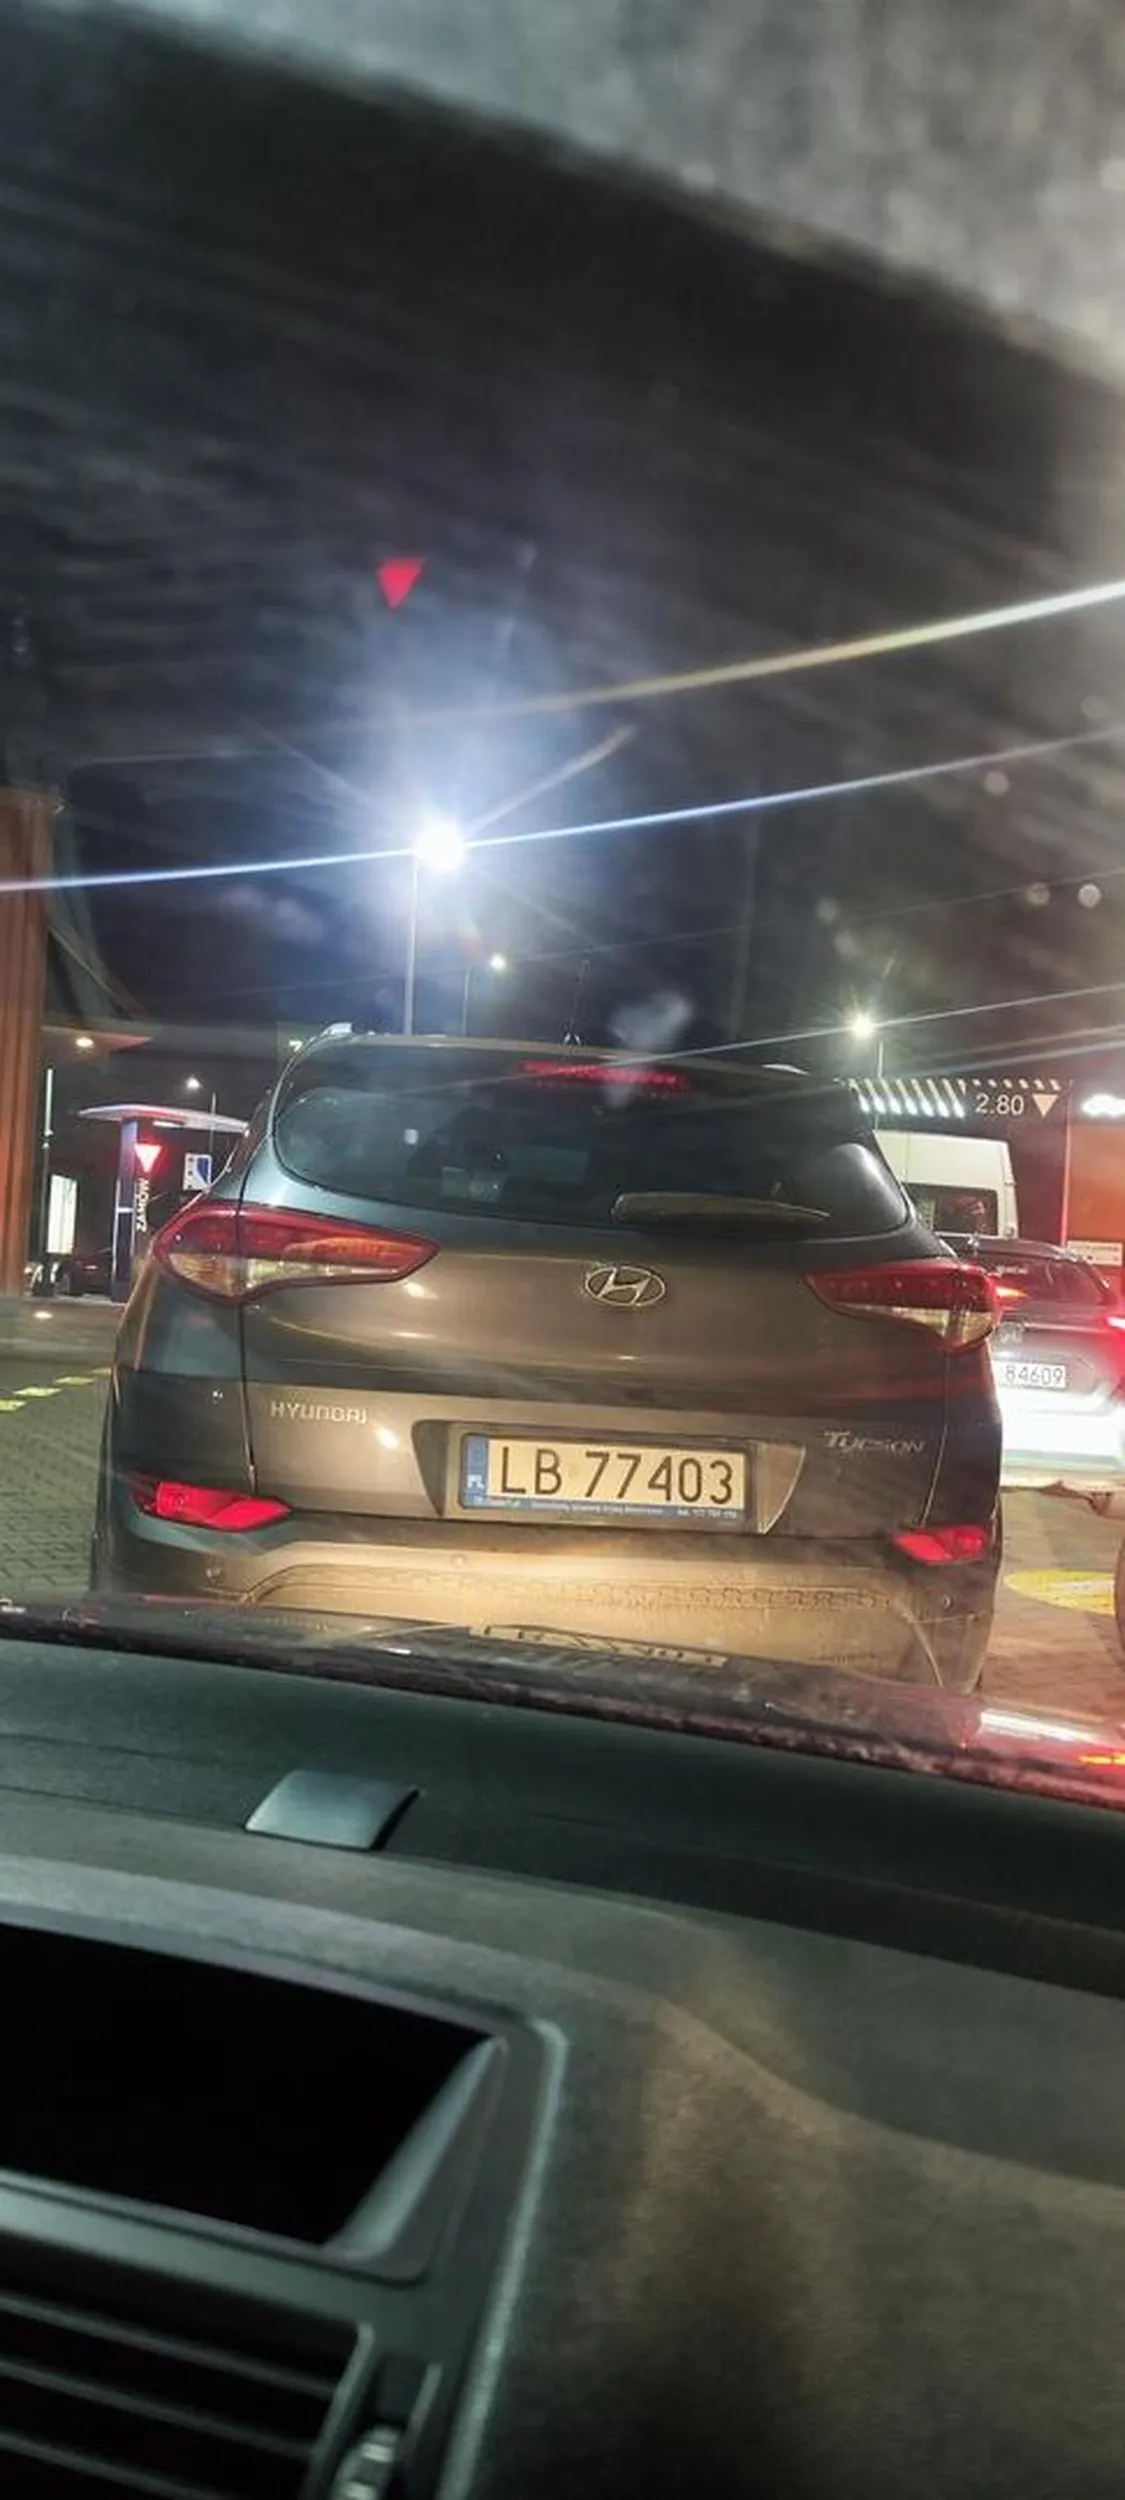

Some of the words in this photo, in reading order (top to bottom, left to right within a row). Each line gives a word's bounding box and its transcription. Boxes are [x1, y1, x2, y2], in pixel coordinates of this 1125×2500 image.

[975, 1093, 1025, 1116] 2.80
[1005, 1364, 1064, 1385] 84609
[270, 1401, 368, 1425] HYUNDAI
[823, 1430, 927, 1454] TUCSON
[500, 1446, 563, 1496] LB
[584, 1450, 734, 1505] 77403
